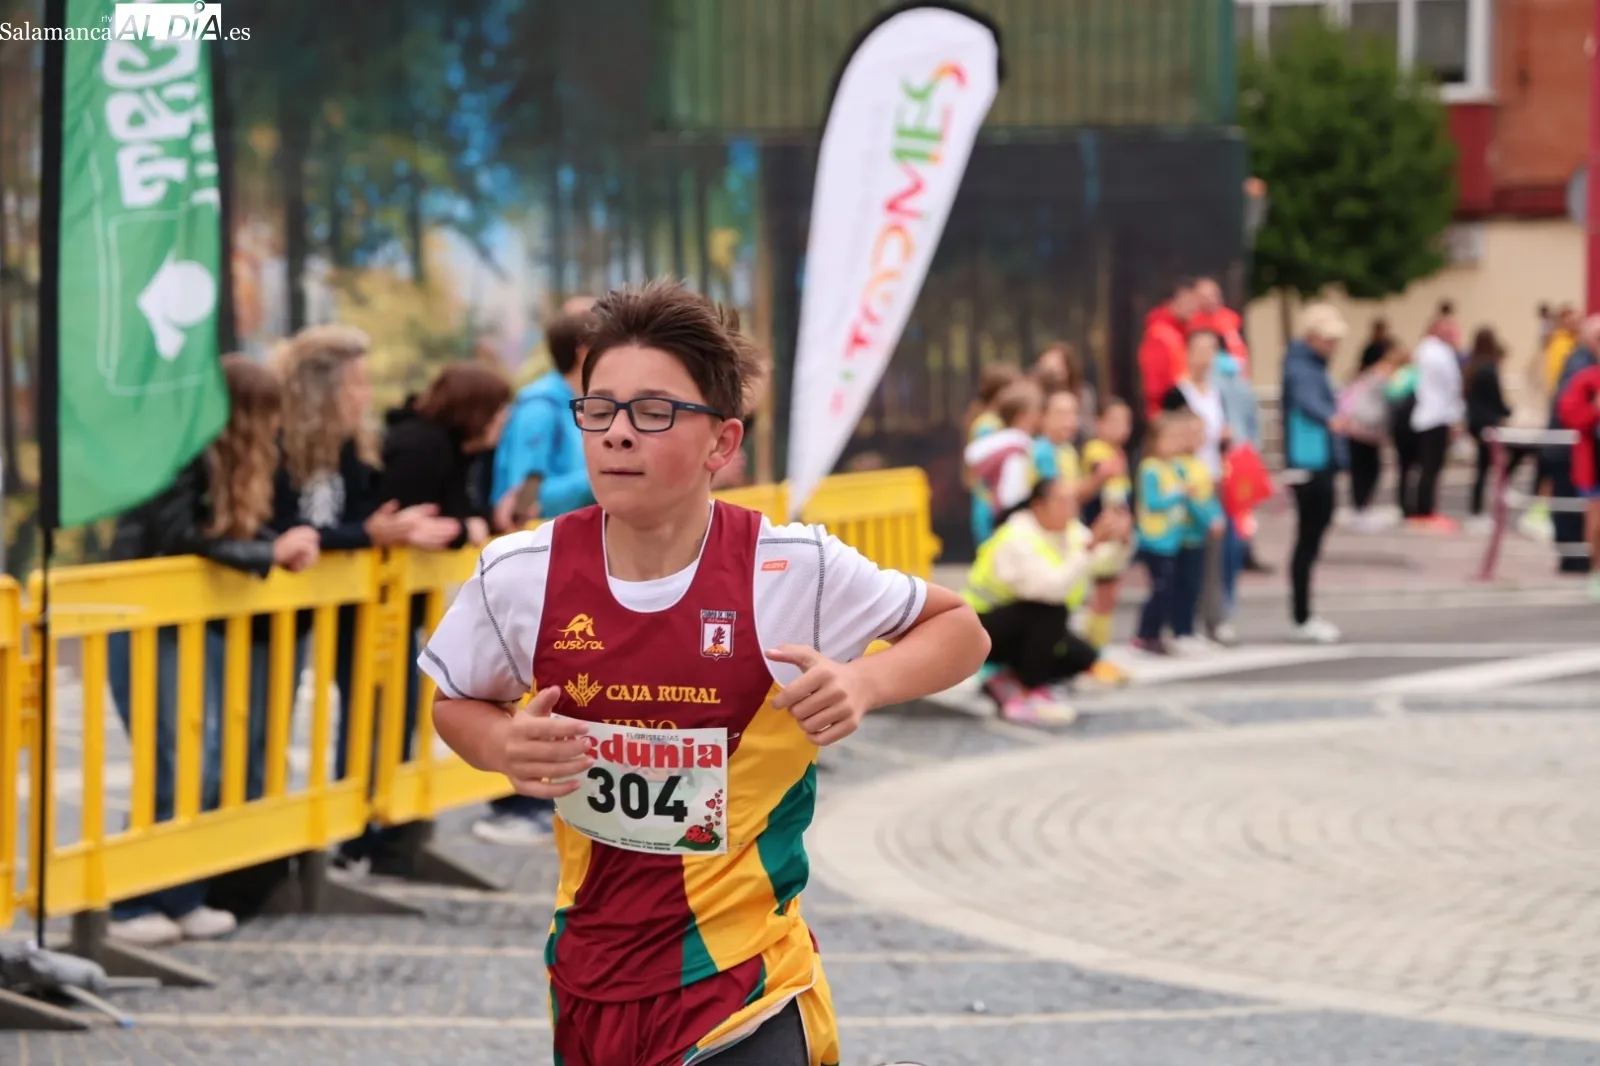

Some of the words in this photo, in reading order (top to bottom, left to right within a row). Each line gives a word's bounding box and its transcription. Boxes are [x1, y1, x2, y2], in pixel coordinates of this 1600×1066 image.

[553, 640, 605, 650] austral
[605, 684, 653, 702] CAJA
[657, 685, 721, 704] RURAL
[586, 766, 689, 823] 304
